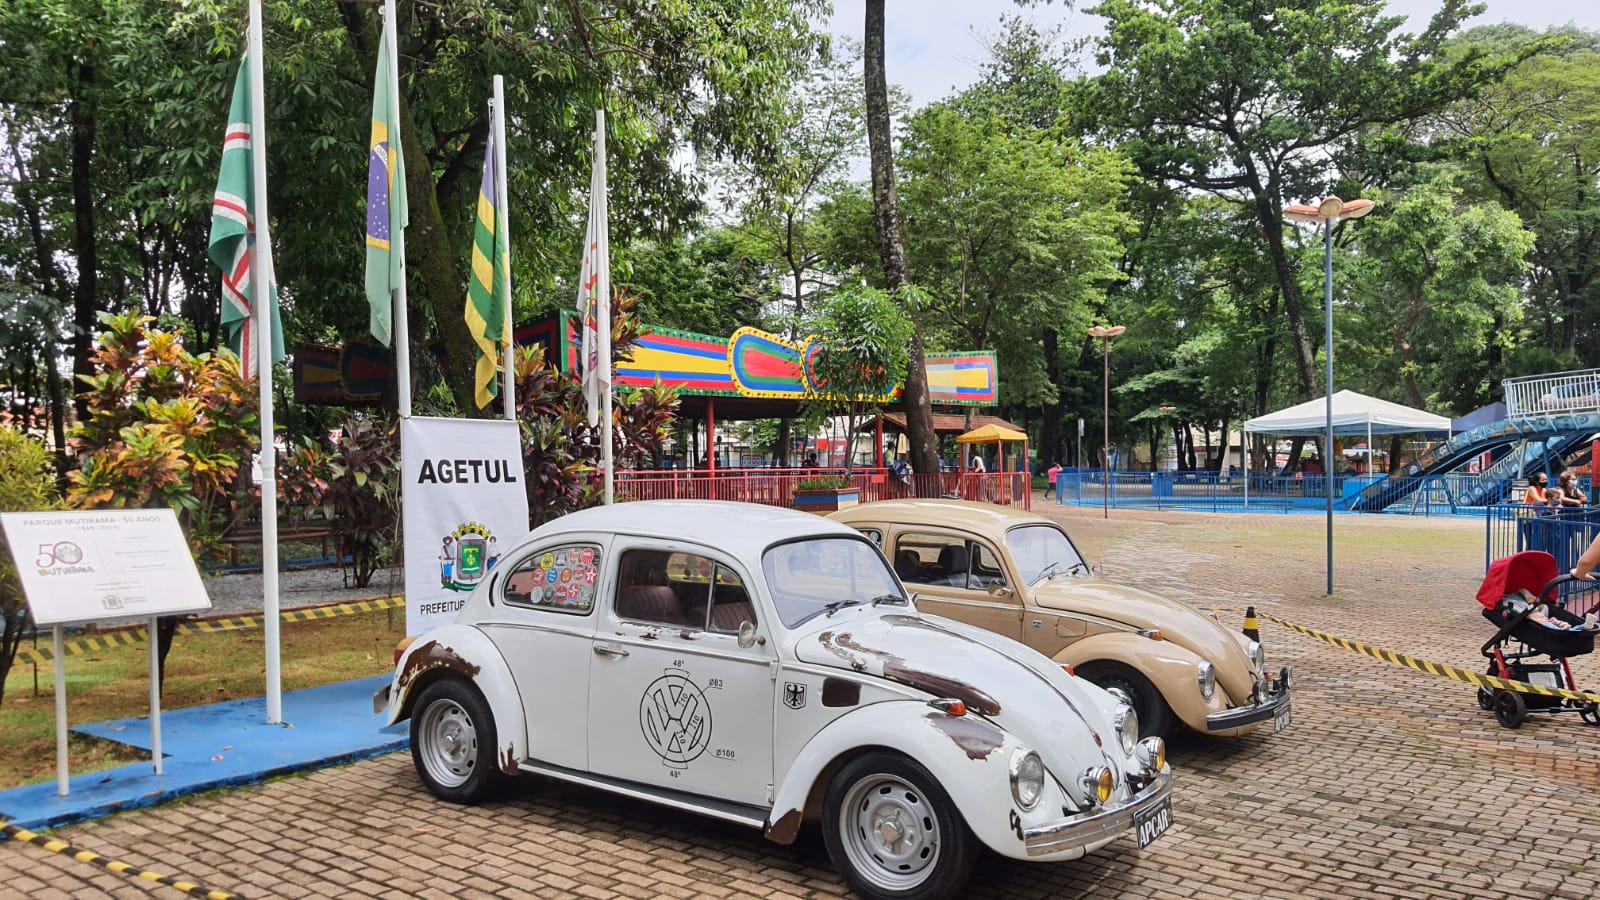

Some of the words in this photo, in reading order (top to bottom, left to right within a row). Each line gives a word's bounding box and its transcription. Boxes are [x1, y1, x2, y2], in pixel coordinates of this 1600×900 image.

[417, 459, 517, 484] AGETUL
[23, 518, 63, 526] PARQUE
[35, 541, 83, 568] 50
[420, 600, 465, 615] PREFEITUR
[1139, 808, 1170, 849] APCAR
